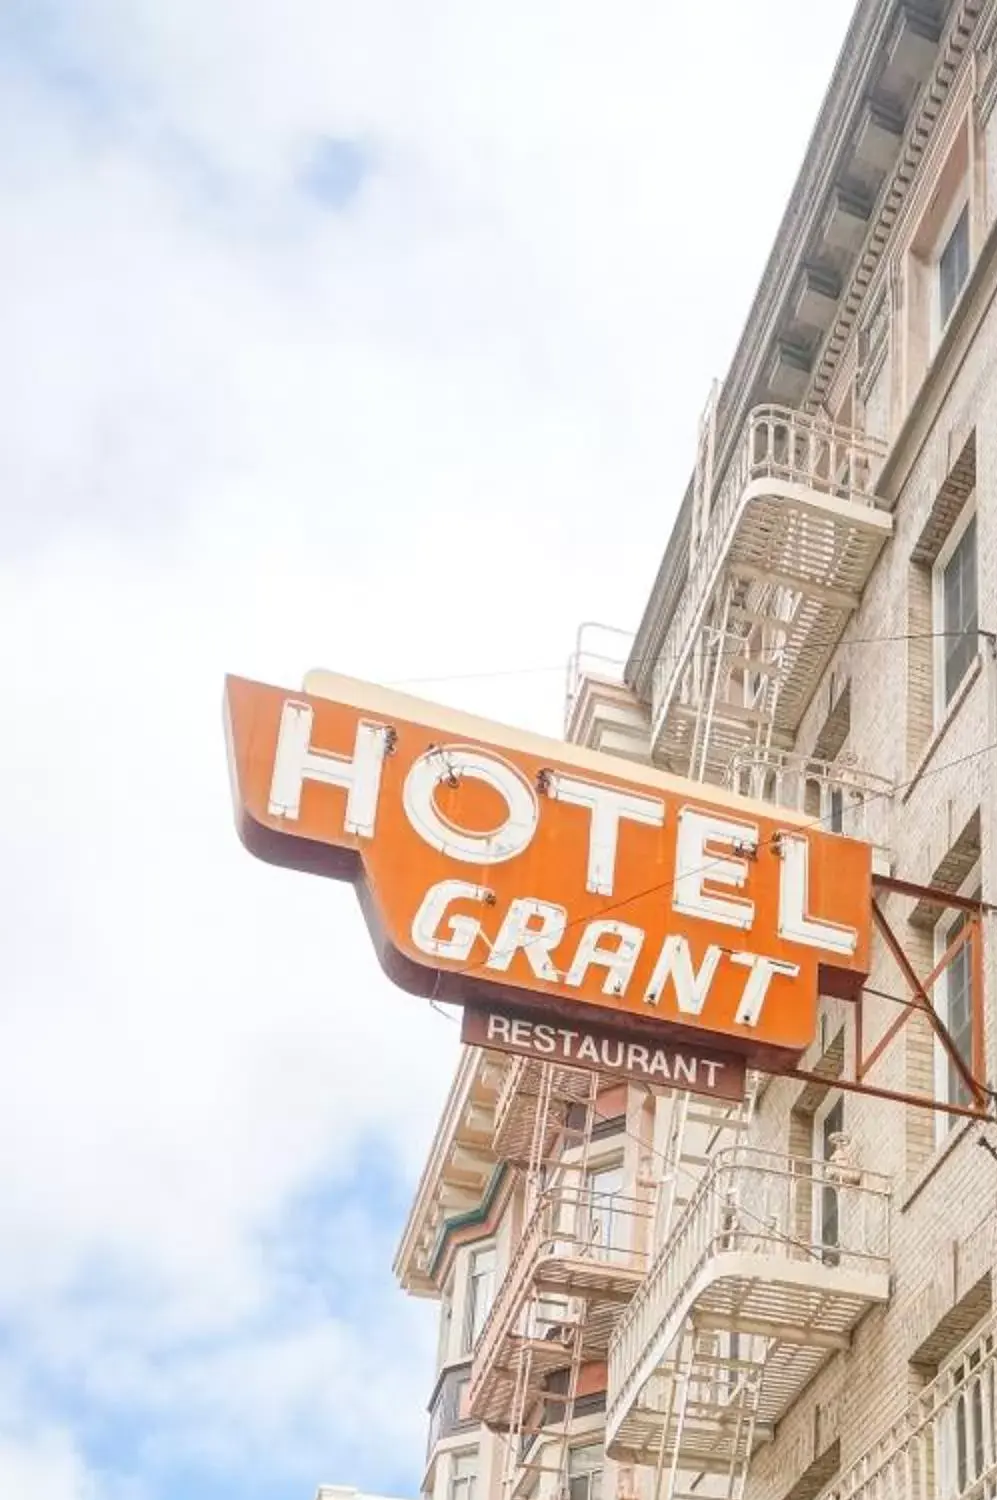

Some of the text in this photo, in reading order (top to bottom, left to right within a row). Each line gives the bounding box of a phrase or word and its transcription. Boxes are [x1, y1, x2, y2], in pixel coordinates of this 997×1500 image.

[267, 700, 858, 955] HOTEL
[411, 879, 799, 1027] GRANT
[486, 1014, 724, 1089] RESTAURANT
